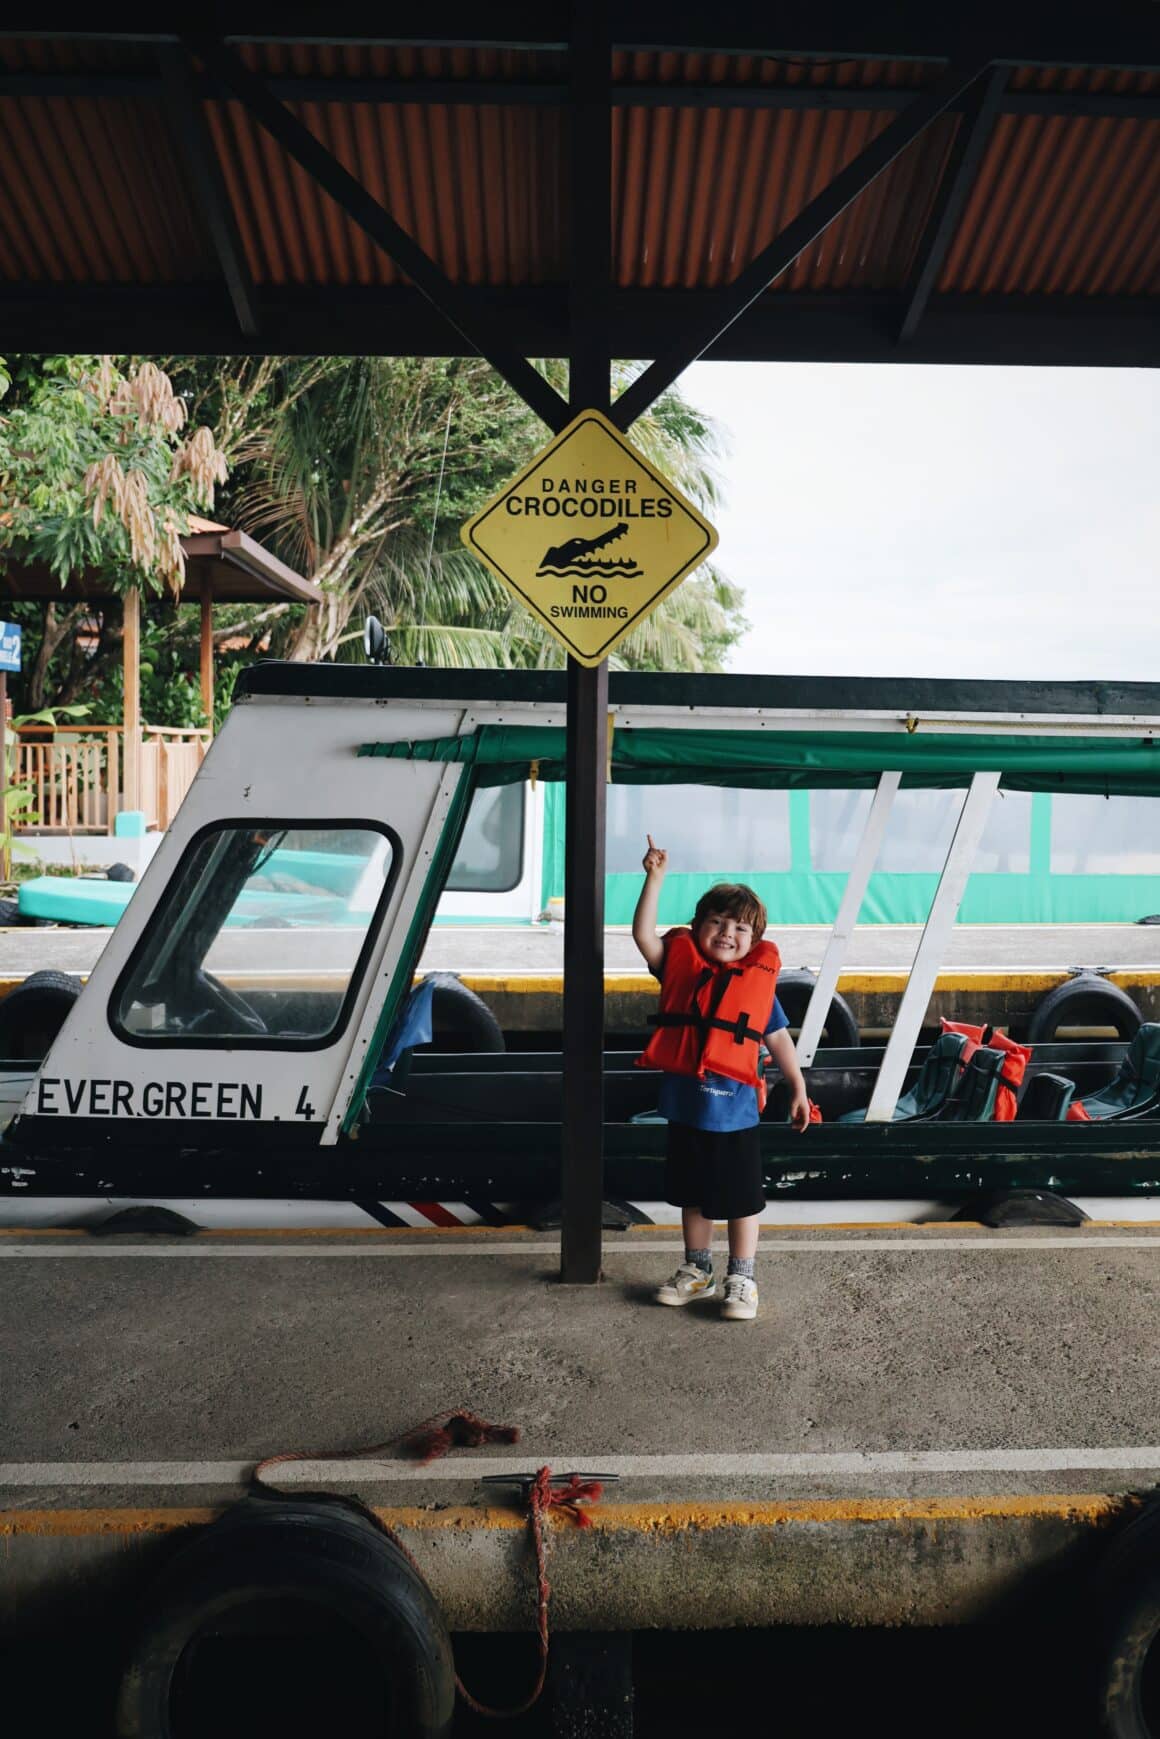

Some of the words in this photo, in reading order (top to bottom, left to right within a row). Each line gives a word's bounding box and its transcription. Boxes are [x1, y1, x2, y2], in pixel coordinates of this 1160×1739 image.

[542, 479, 637, 494] DANGER
[506, 496, 673, 518] CROCODILES
[572, 585, 607, 604] NO
[550, 606, 628, 619] SWIMMING
[295, 1085, 316, 1120] 4
